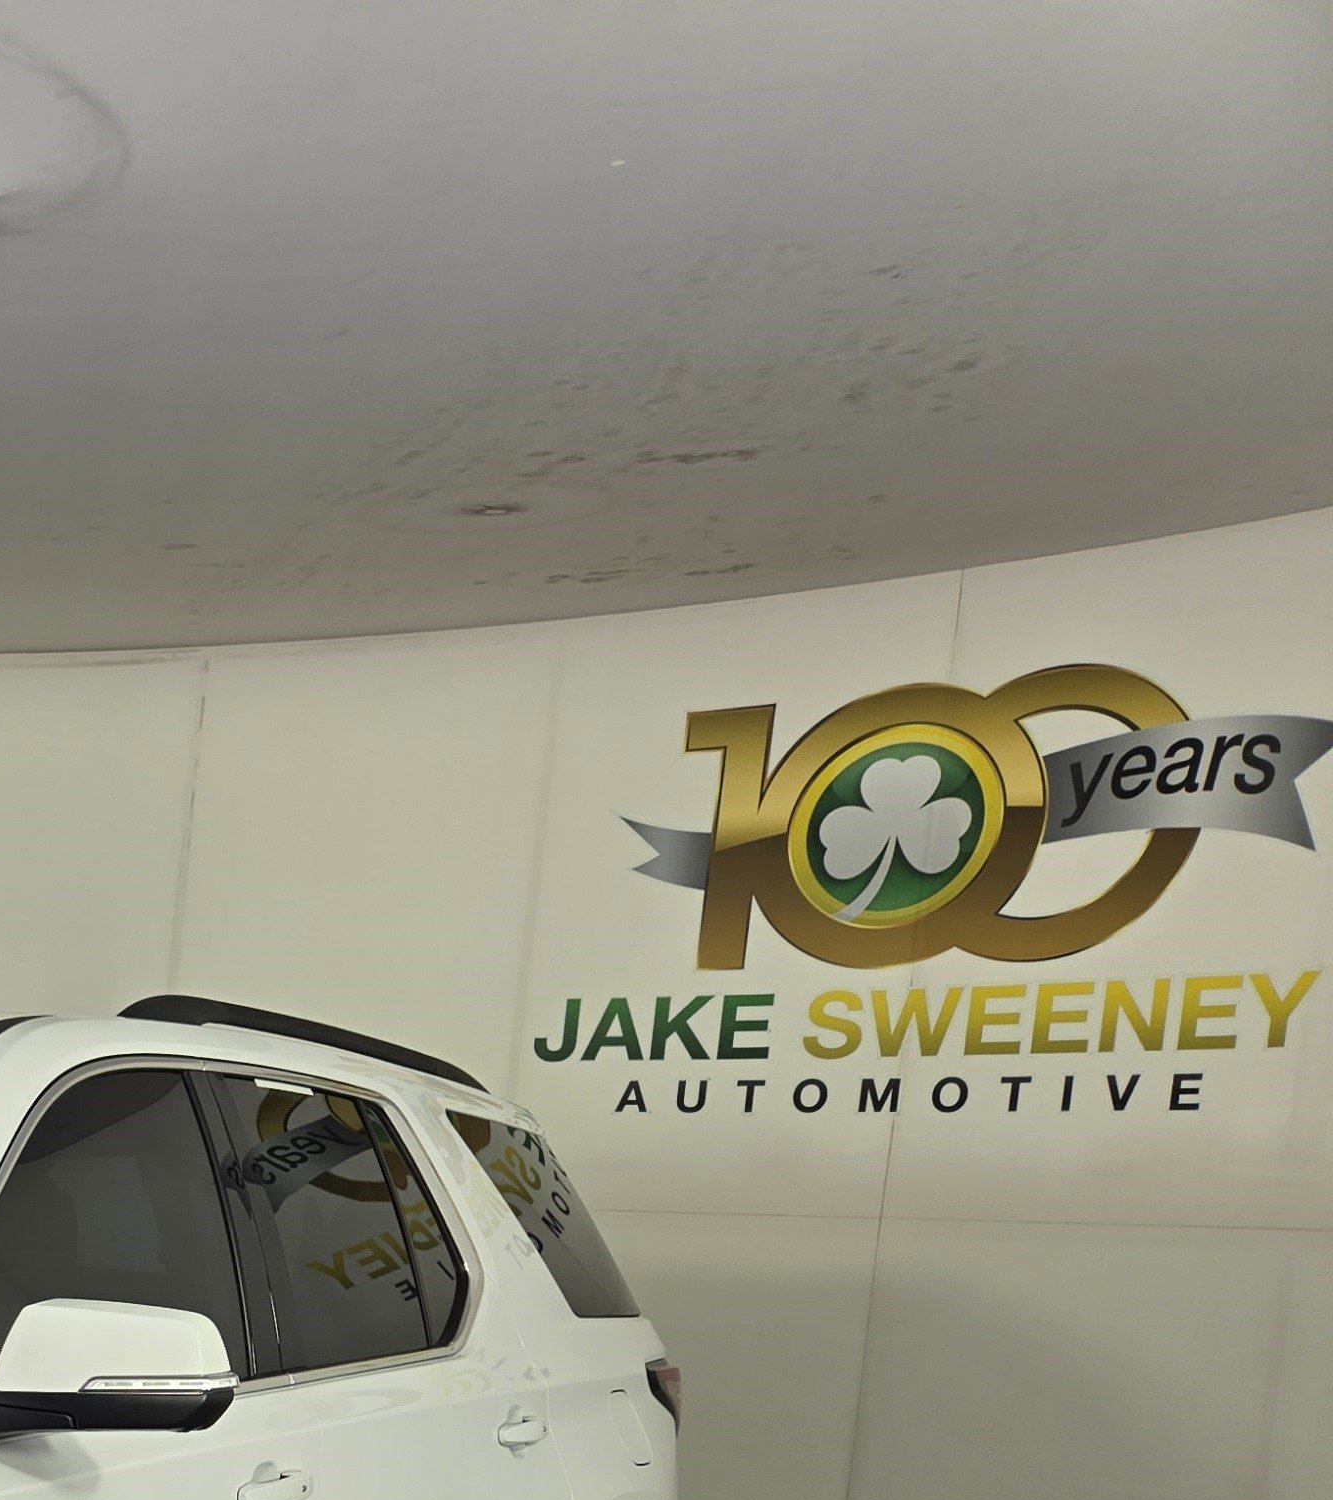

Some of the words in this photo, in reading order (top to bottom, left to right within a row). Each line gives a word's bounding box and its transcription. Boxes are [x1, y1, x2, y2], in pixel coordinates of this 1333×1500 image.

[684, 663, 1203, 970] 100
[1058, 733, 1281, 828] years
[533, 993, 775, 1062] JAKE
[802, 969, 1322, 1059] SWEENEY
[614, 1072, 1205, 1114] AUTOMOTIVE
